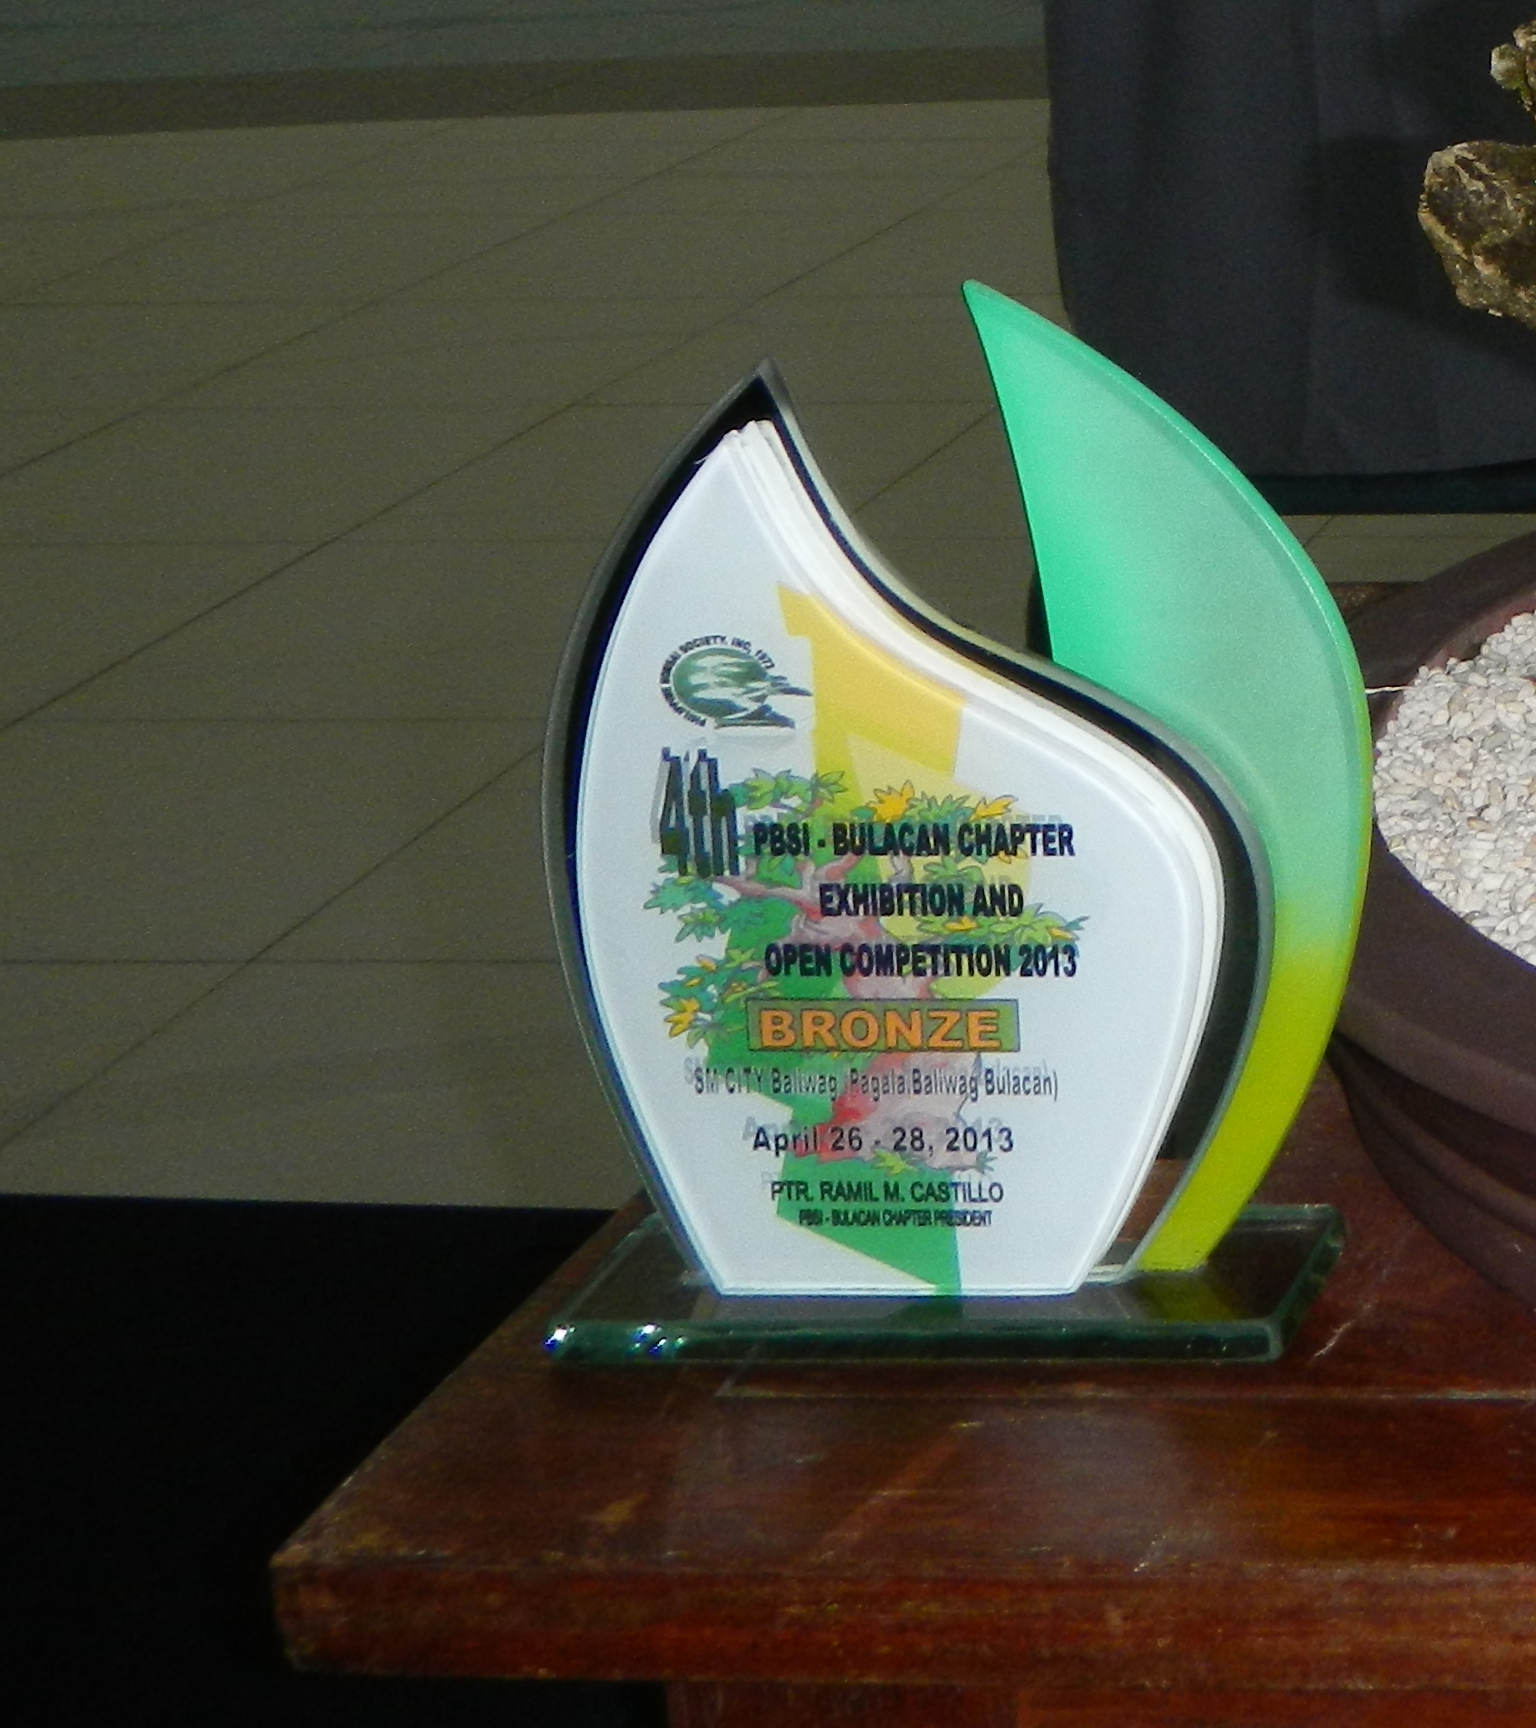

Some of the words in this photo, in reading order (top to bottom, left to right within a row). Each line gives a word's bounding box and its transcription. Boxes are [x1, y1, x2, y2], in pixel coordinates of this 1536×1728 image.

[654, 745, 740, 878] 4th
[752, 822, 811, 856] PBSI
[832, 822, 951, 857] BULACAN
[956, 822, 1077, 857] CHAPTER
[818, 882, 964, 917] EXHIBITION
[972, 883, 1024, 917] AND
[763, 943, 834, 977] OPEN
[839, 943, 1012, 977] COMPETITION
[1018, 943, 1078, 978] 2013
[758, 1007, 1002, 1051] BRONZE
[752, 1125, 819, 1158] April
[830, 1126, 864, 1153] 26
[891, 1126, 935, 1157] 28,
[944, 1126, 1015, 1153] 2013
[770, 1180, 814, 1203] PTR.
[819, 1180, 881, 1203] RAMIL
[884, 1181, 905, 1203] M.
[909, 1181, 1005, 1204] CASTILLO
[831, 1209, 881, 1227] BULACAN
[881, 1209, 933, 1227] CHAPTER
